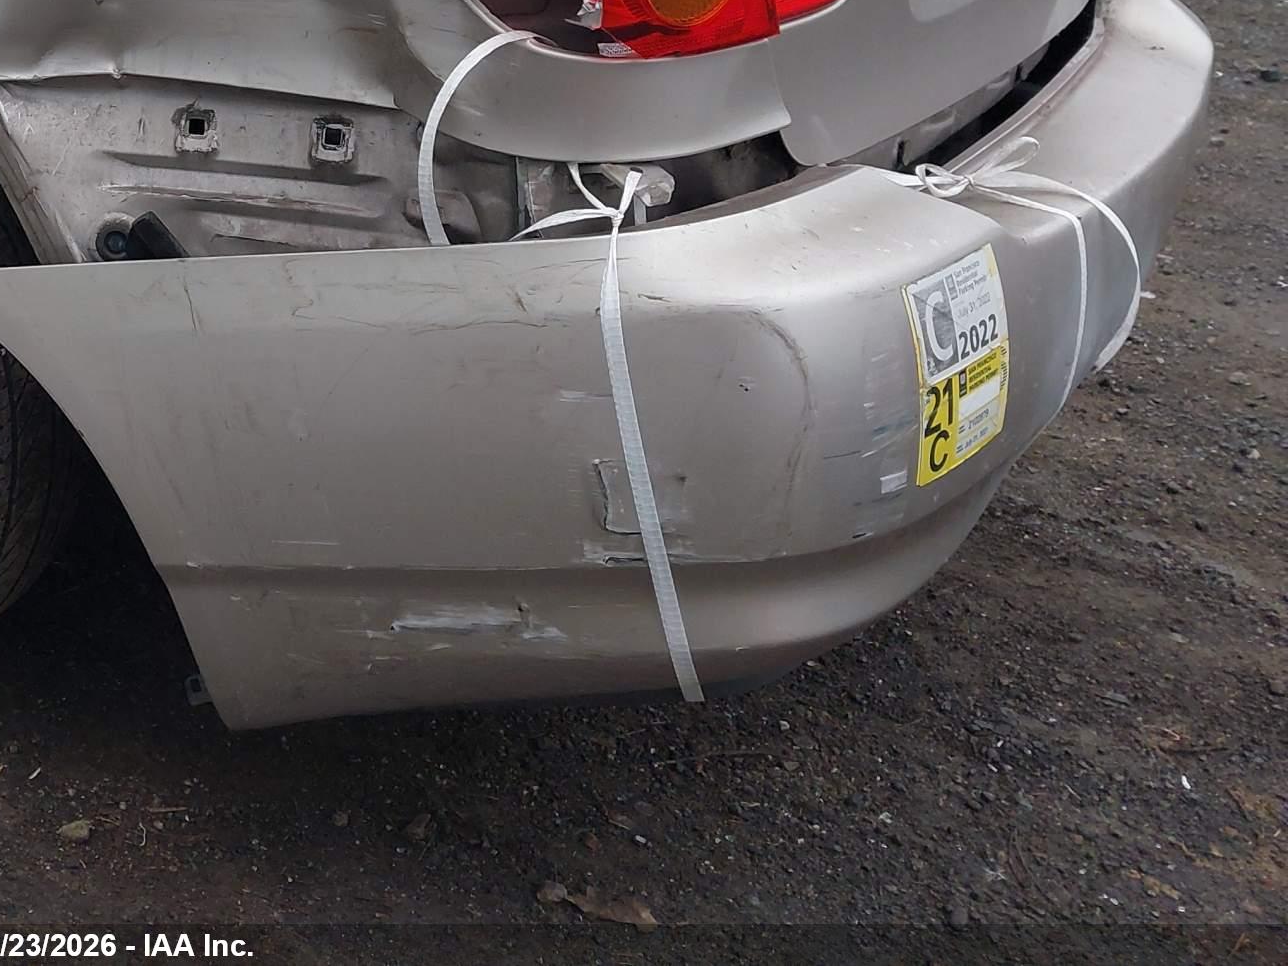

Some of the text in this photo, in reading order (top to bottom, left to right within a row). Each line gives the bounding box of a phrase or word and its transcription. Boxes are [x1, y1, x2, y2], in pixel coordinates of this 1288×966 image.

[925, 290, 954, 362] C
[959, 313, 999, 360] 2022
[924, 378, 954, 439] 21
[929, 430, 951, 472] C
